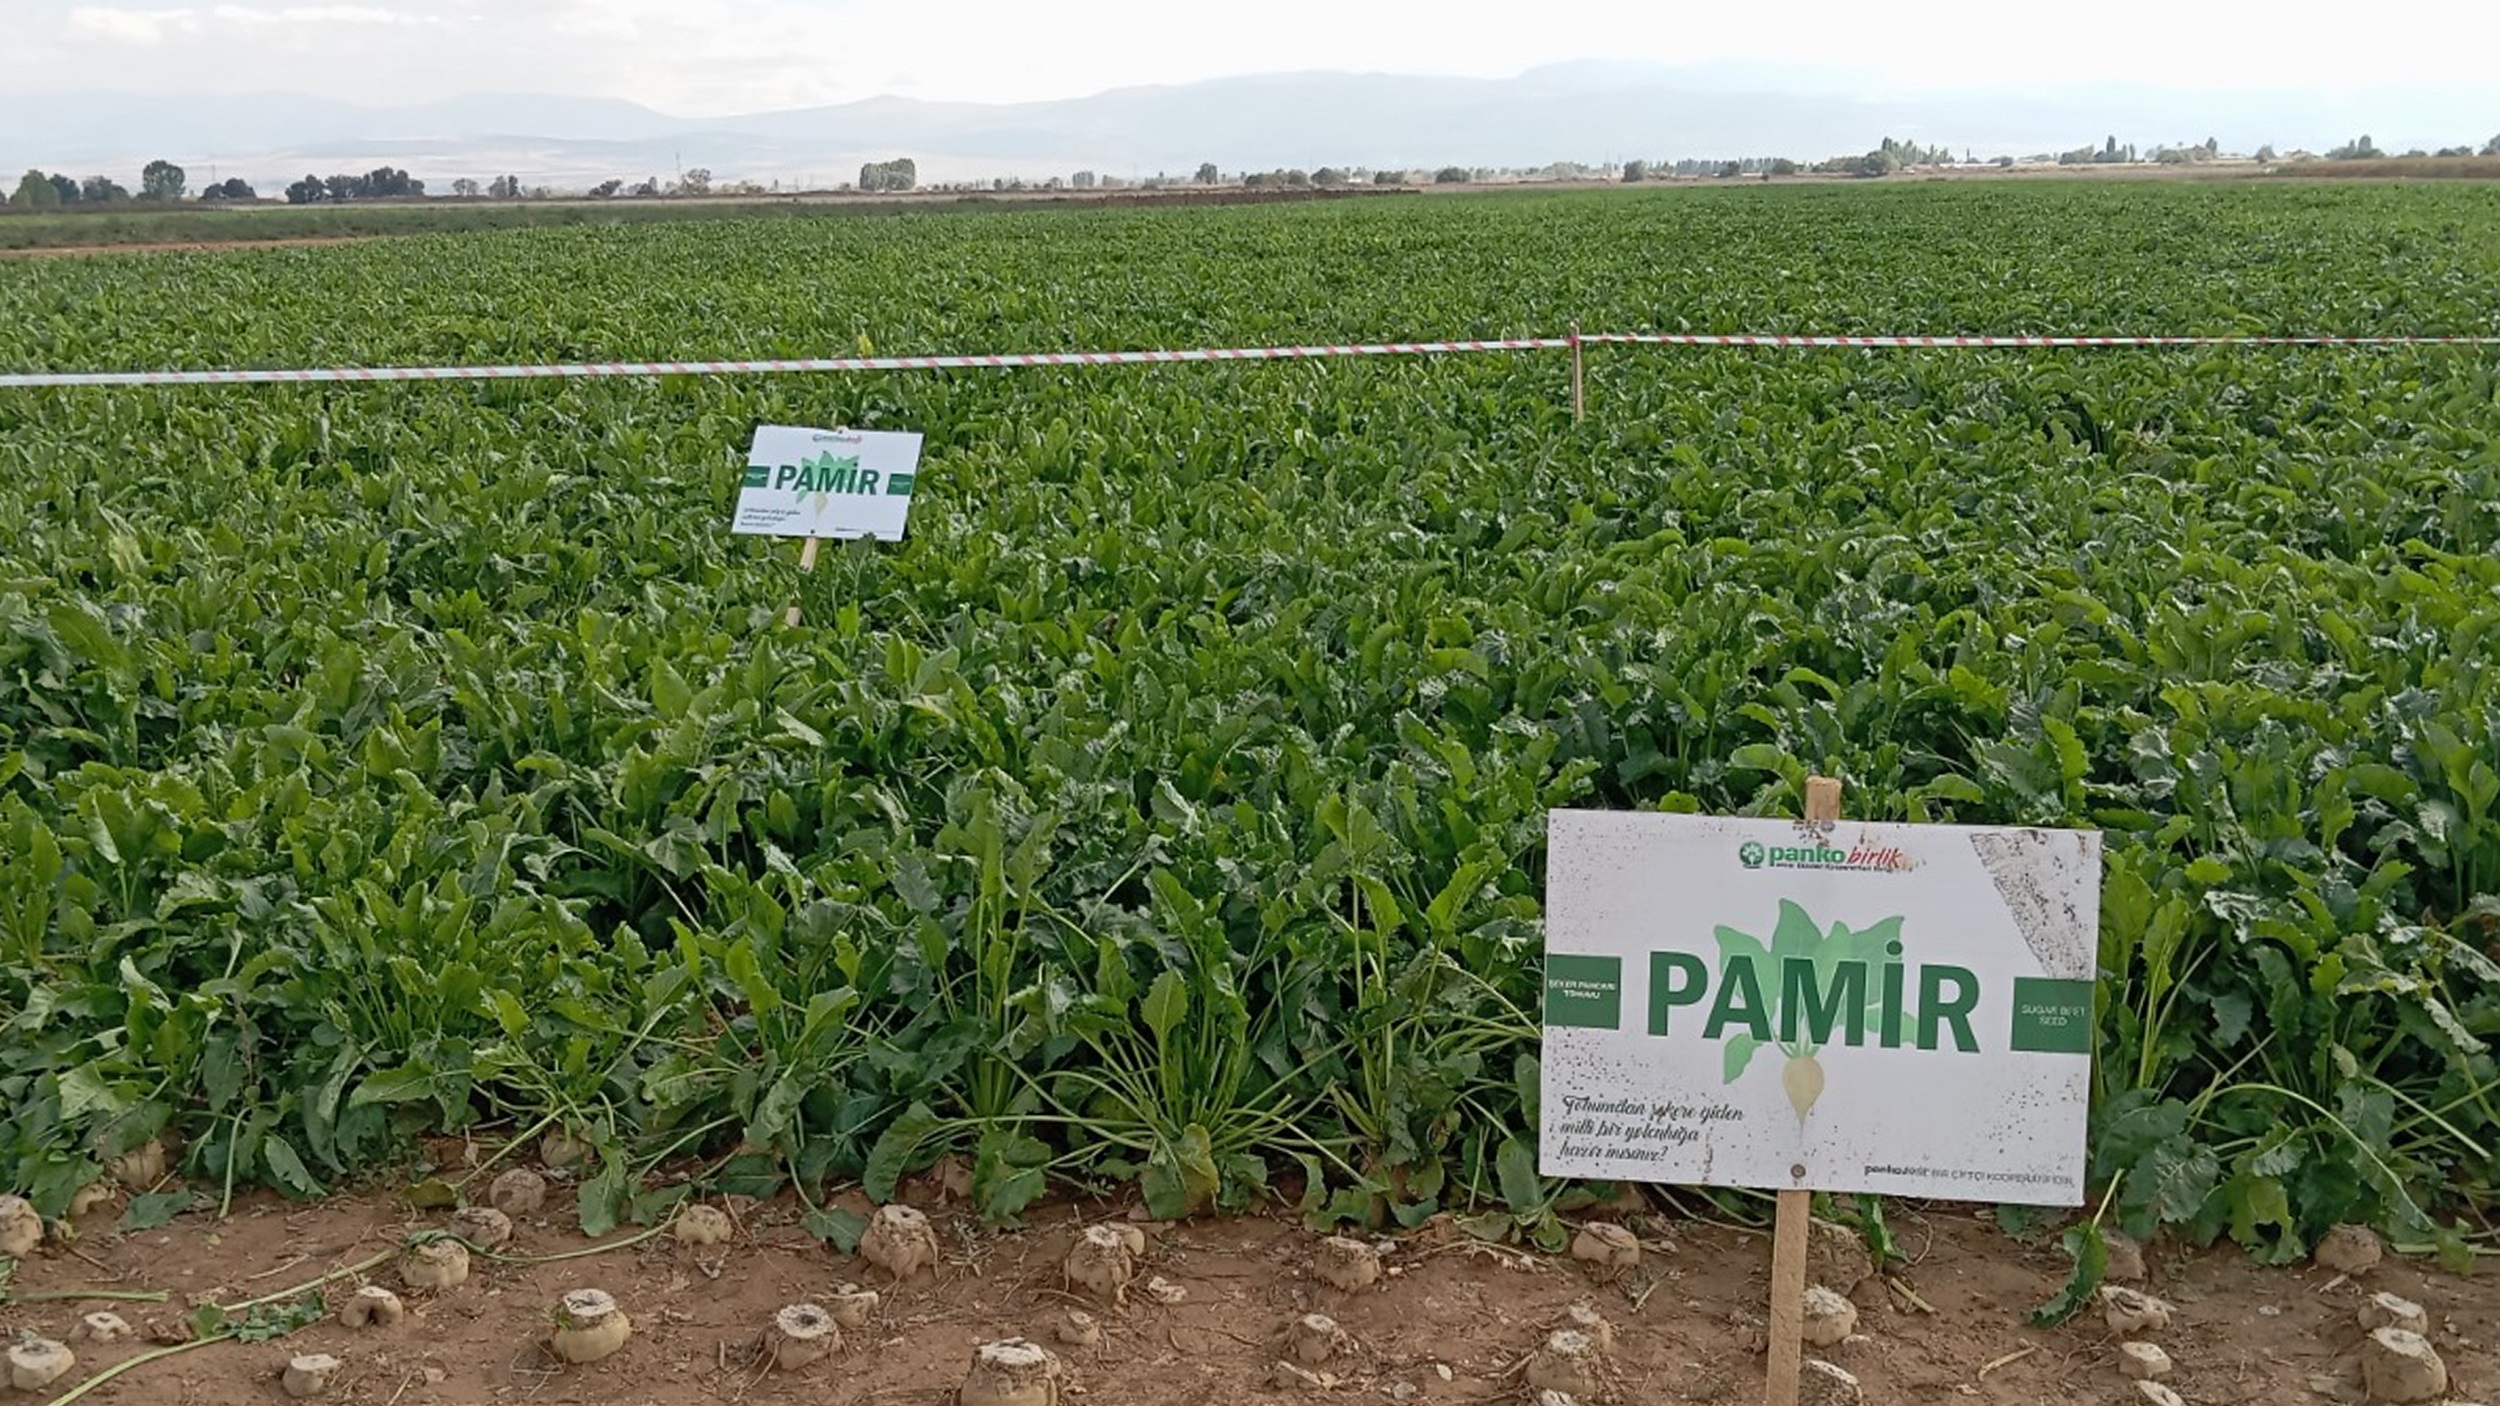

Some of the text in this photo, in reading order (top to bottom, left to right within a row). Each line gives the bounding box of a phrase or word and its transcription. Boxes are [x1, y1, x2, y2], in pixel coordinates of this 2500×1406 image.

[775, 462, 880, 495] PAMİR
[1648, 939, 1981, 1053] PAMİR
[1700, 1103, 1745, 1125] giden
